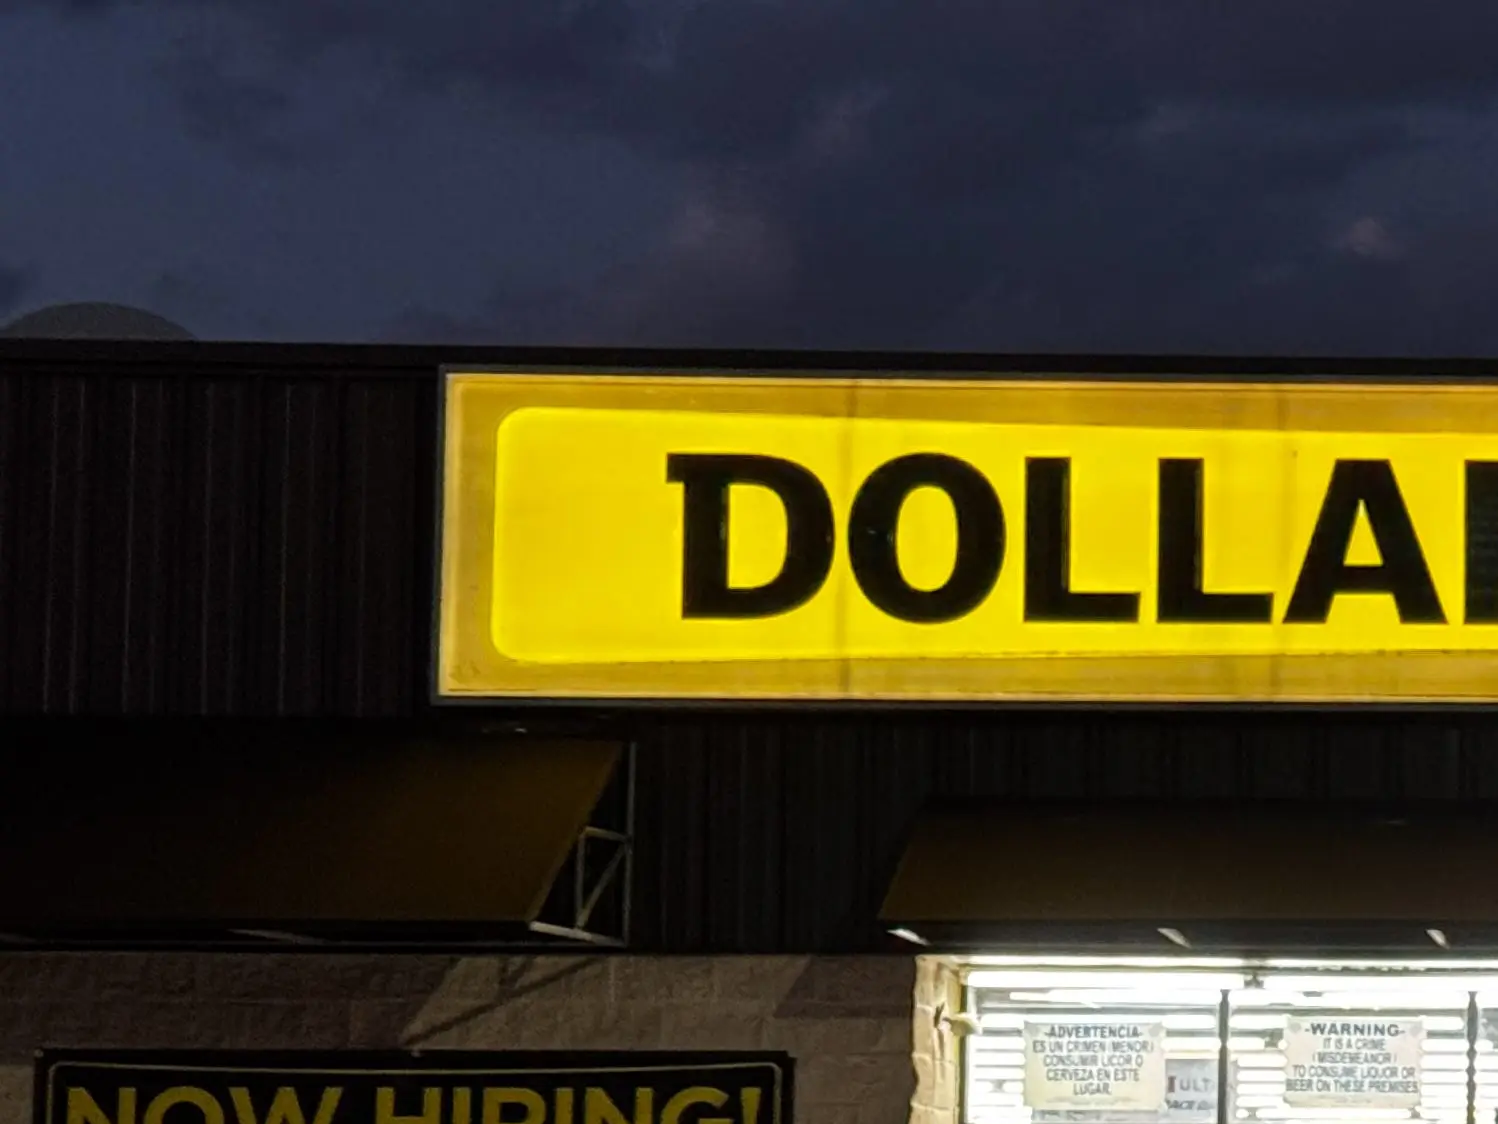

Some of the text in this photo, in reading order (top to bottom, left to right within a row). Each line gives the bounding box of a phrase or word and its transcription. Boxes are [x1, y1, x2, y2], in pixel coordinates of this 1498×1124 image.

[1033, 1041, 1047, 1053] ES
[1050, 1041, 1063, 1053] UN
[1067, 1041, 1105, 1054] CRIMEN
[1323, 1038, 1386, 1051] IT IS A CRIME
[1043, 1055, 1143, 1067] CONSUMIR LICOR O
[1046, 1069, 1140, 1082] CERVEZA EN ESTE
[1293, 1065, 1416, 1079] TO CONSUME LIQUOR OR
[1286, 1078, 1313, 1092] BEER
[1316, 1079, 1331, 1092] ON
[1334, 1079, 1366, 1093] THESE
